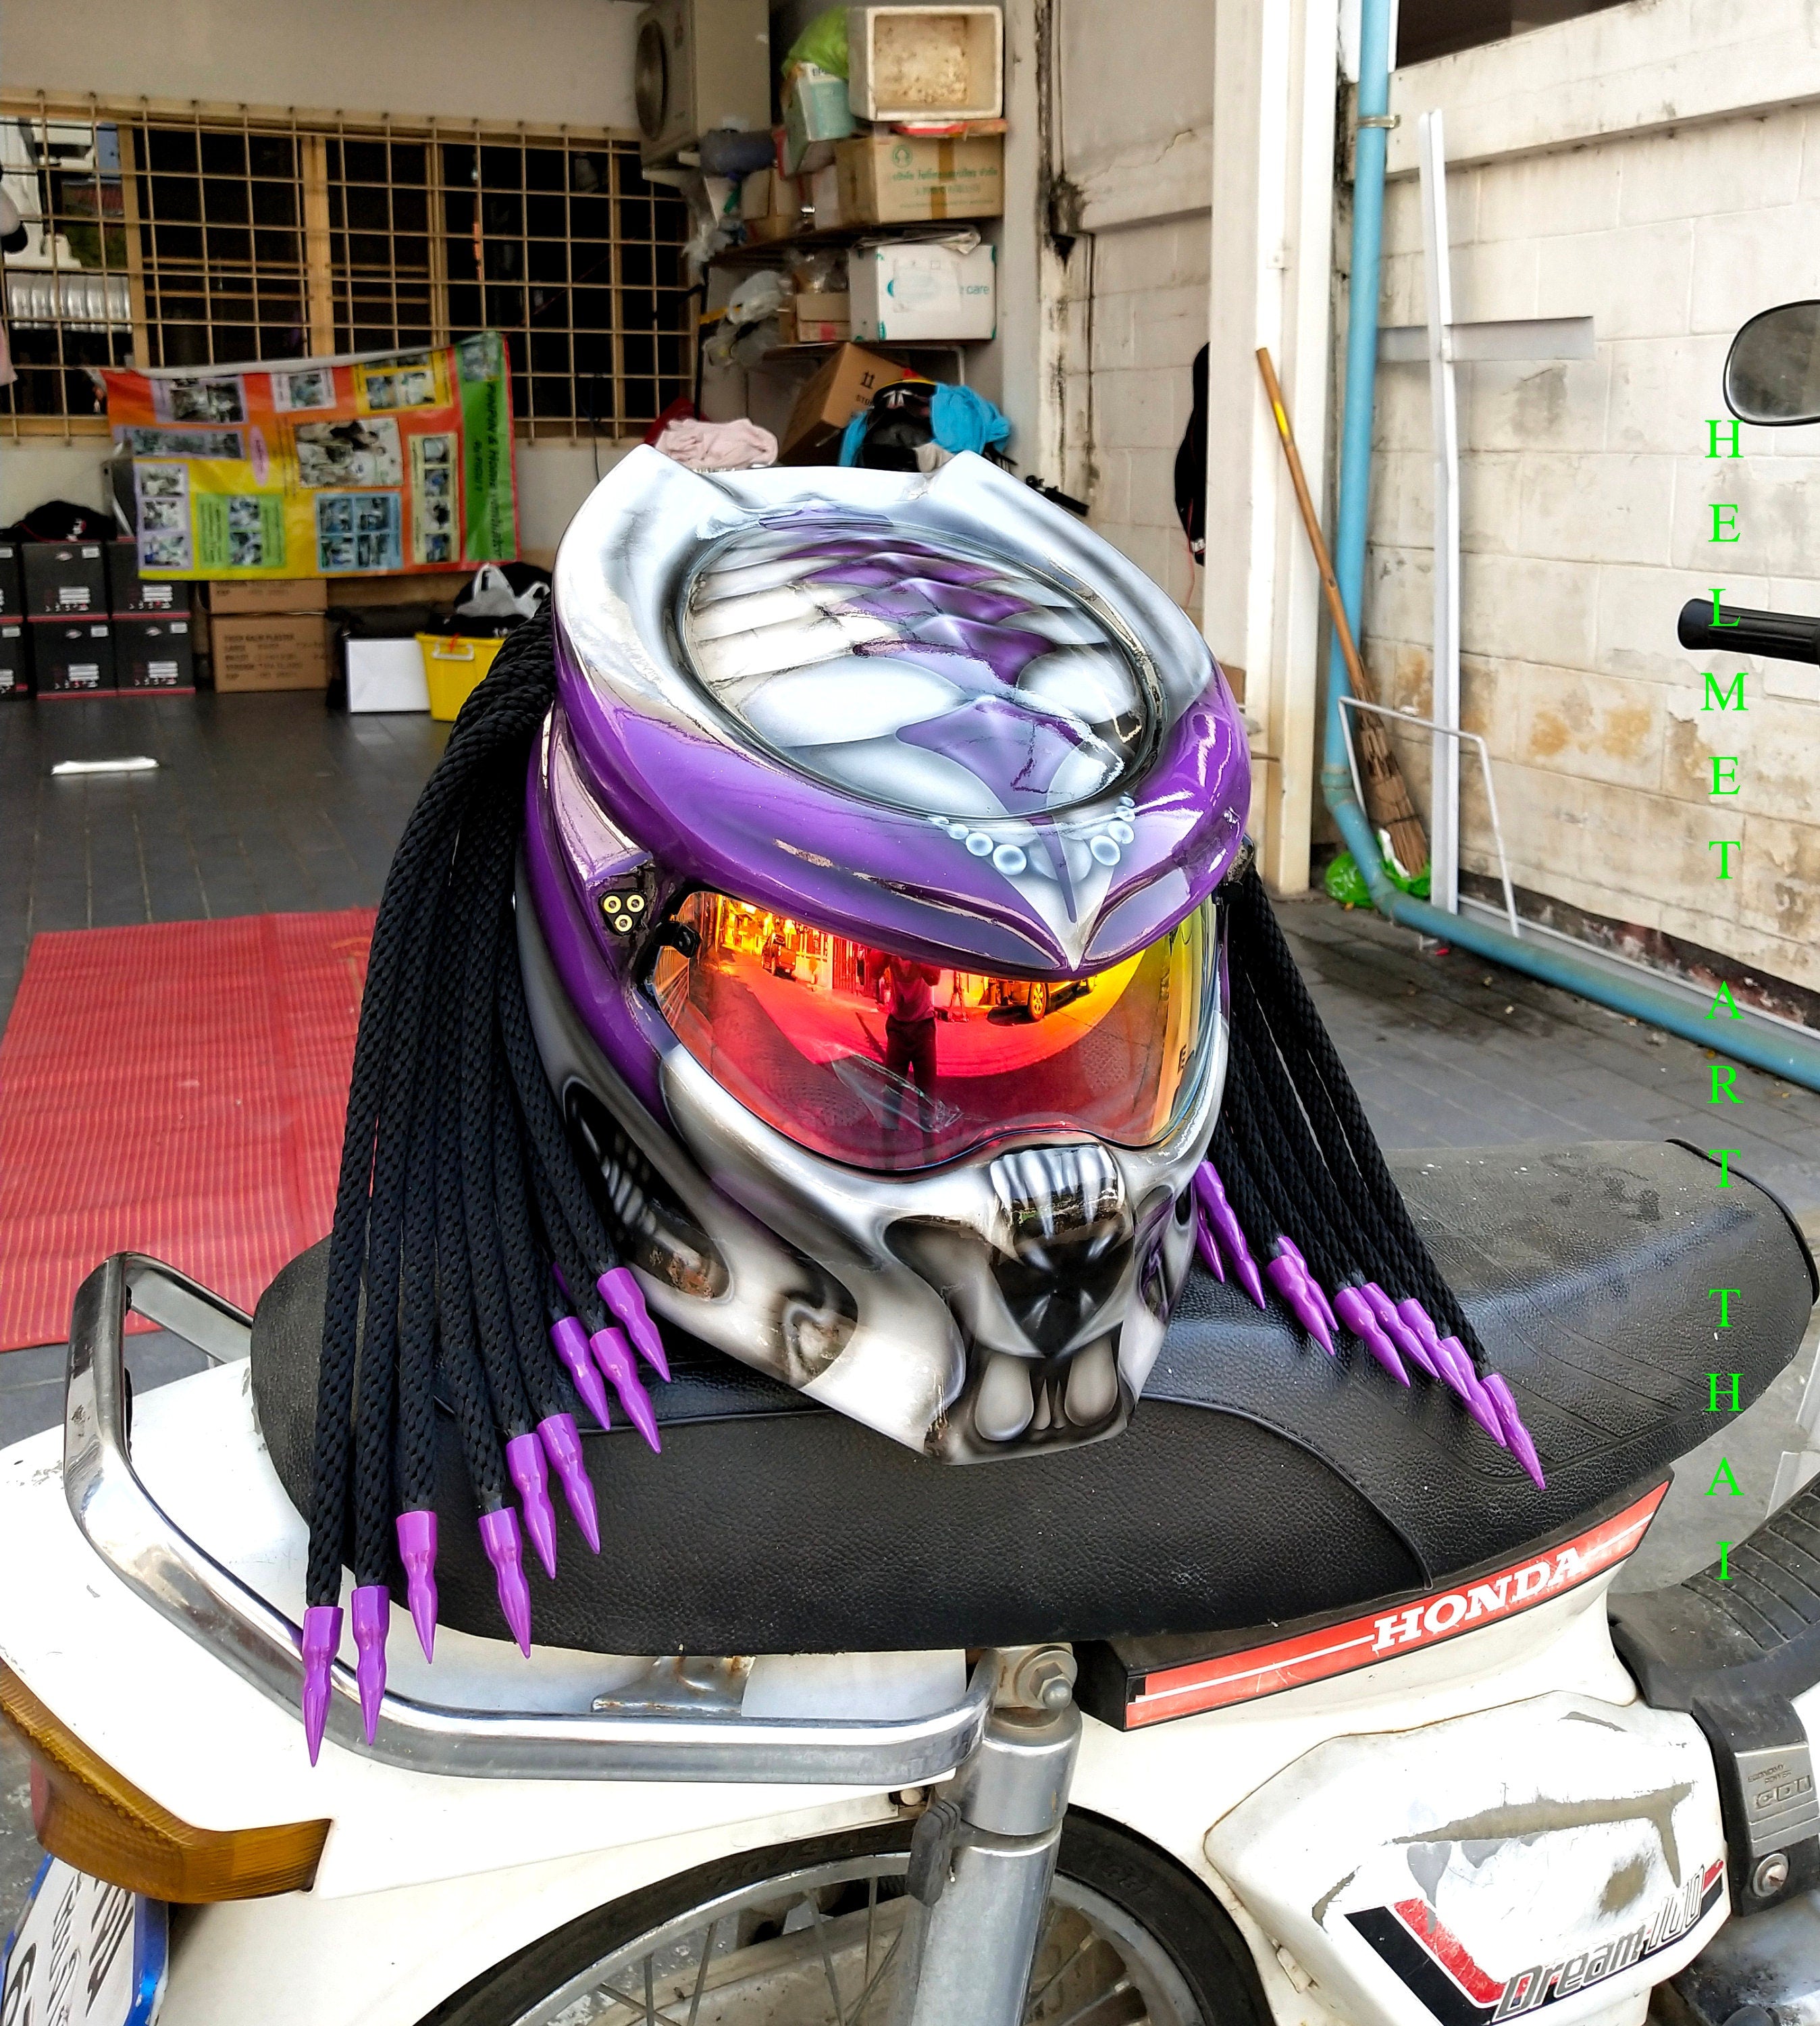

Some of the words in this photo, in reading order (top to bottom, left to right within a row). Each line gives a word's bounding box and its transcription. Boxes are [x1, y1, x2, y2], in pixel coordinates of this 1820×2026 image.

[966, 284, 990, 295] care
[1372, 1547, 1586, 1652] HONDA
[1755, 1775, 1812, 1810] CDI
